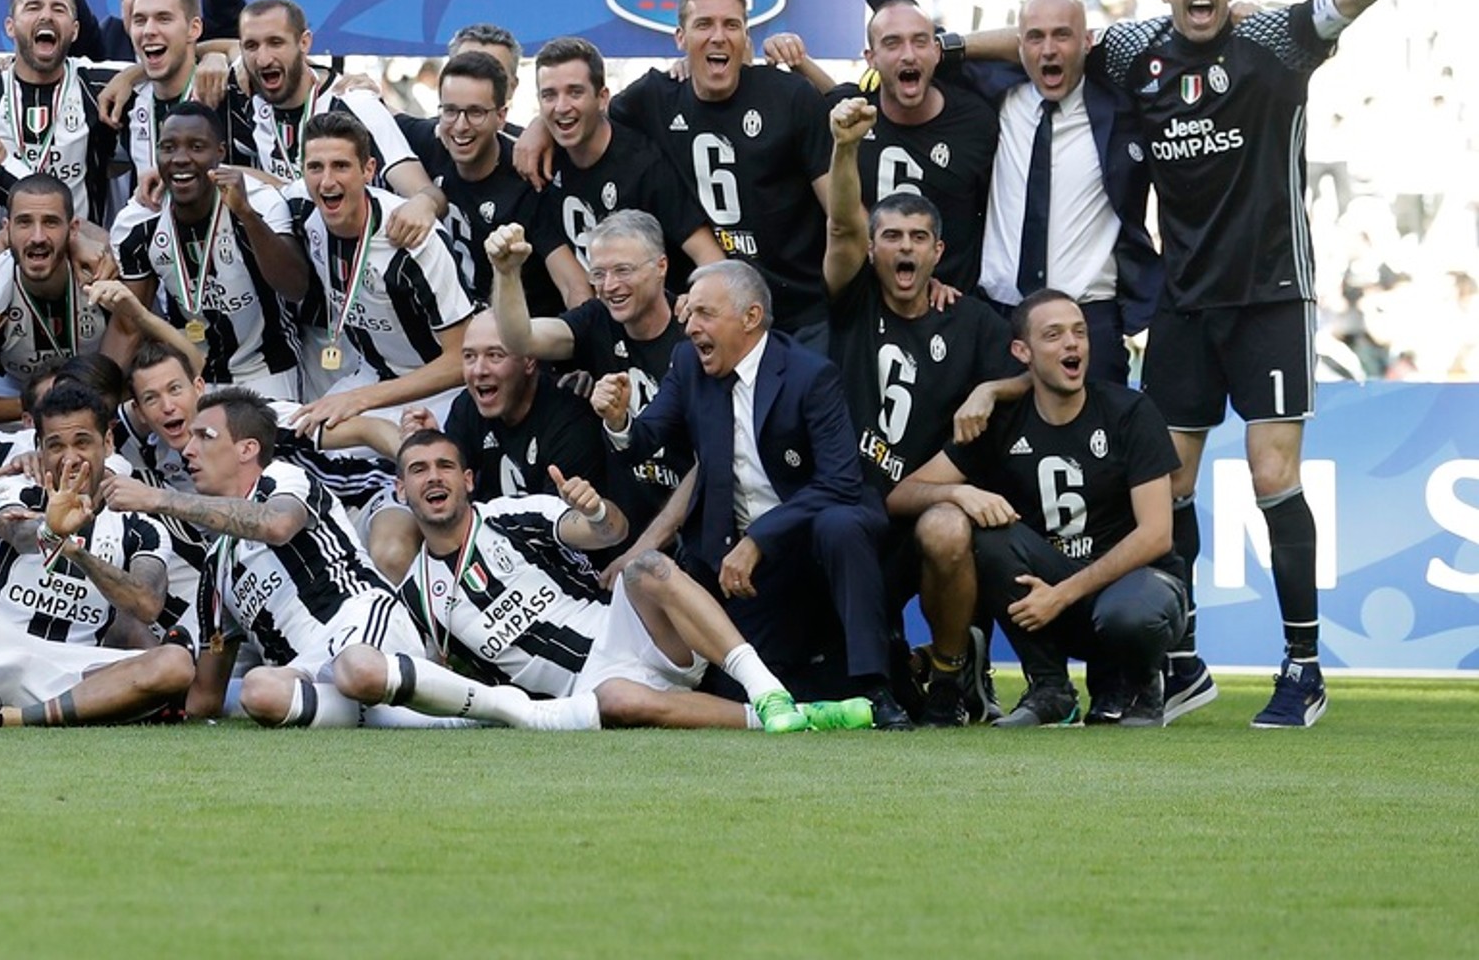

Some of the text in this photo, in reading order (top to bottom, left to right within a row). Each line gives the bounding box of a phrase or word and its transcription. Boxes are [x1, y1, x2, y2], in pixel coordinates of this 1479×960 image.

[1151, 128, 1244, 161] COMPASS
[1164, 117, 1215, 140] Jeep
[693, 132, 741, 226] 6
[877, 343, 918, 445] 6
[1269, 370, 1286, 416] 1
[1037, 456, 1089, 538] 6
[8, 584, 103, 625] COMPASS
[38, 574, 88, 601] Jeep
[232, 572, 258, 609] Jeep
[479, 585, 558, 661] COMPASS
[483, 588, 524, 631] Jeep
